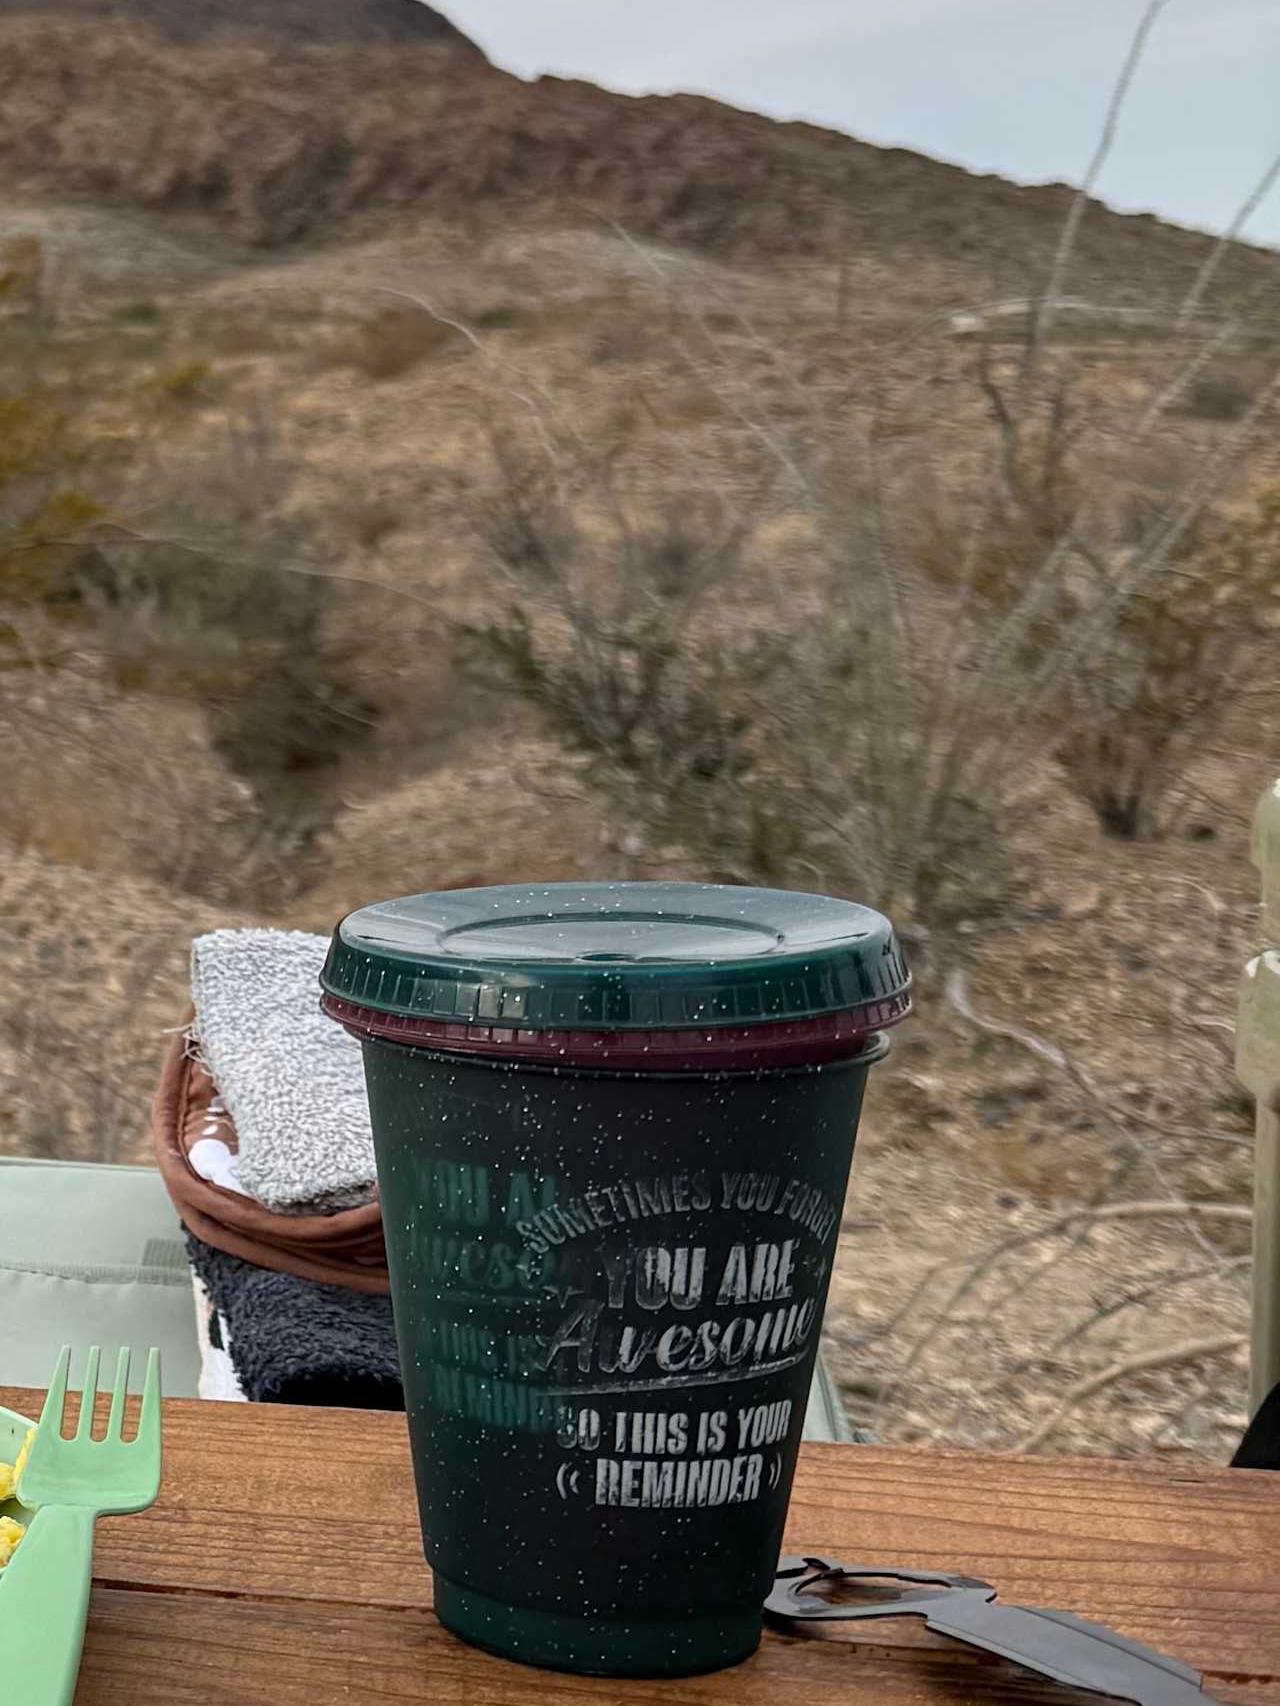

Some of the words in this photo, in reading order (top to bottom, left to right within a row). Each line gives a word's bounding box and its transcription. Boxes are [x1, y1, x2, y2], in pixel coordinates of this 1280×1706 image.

[516, 1173, 711, 1253] SOMETIMES
[721, 1172, 780, 1212] YOU
[600, 1244, 706, 1311] YOU
[715, 1238, 800, 1306] ARE
[536, 1297, 816, 1374] Awesome
[557, 1406, 601, 1451] SO
[615, 1411, 689, 1454] THIS
[696, 1409, 728, 1454] IS
[737, 1399, 792, 1450] YOUR
[594, 1452, 764, 1509] REMINDER
